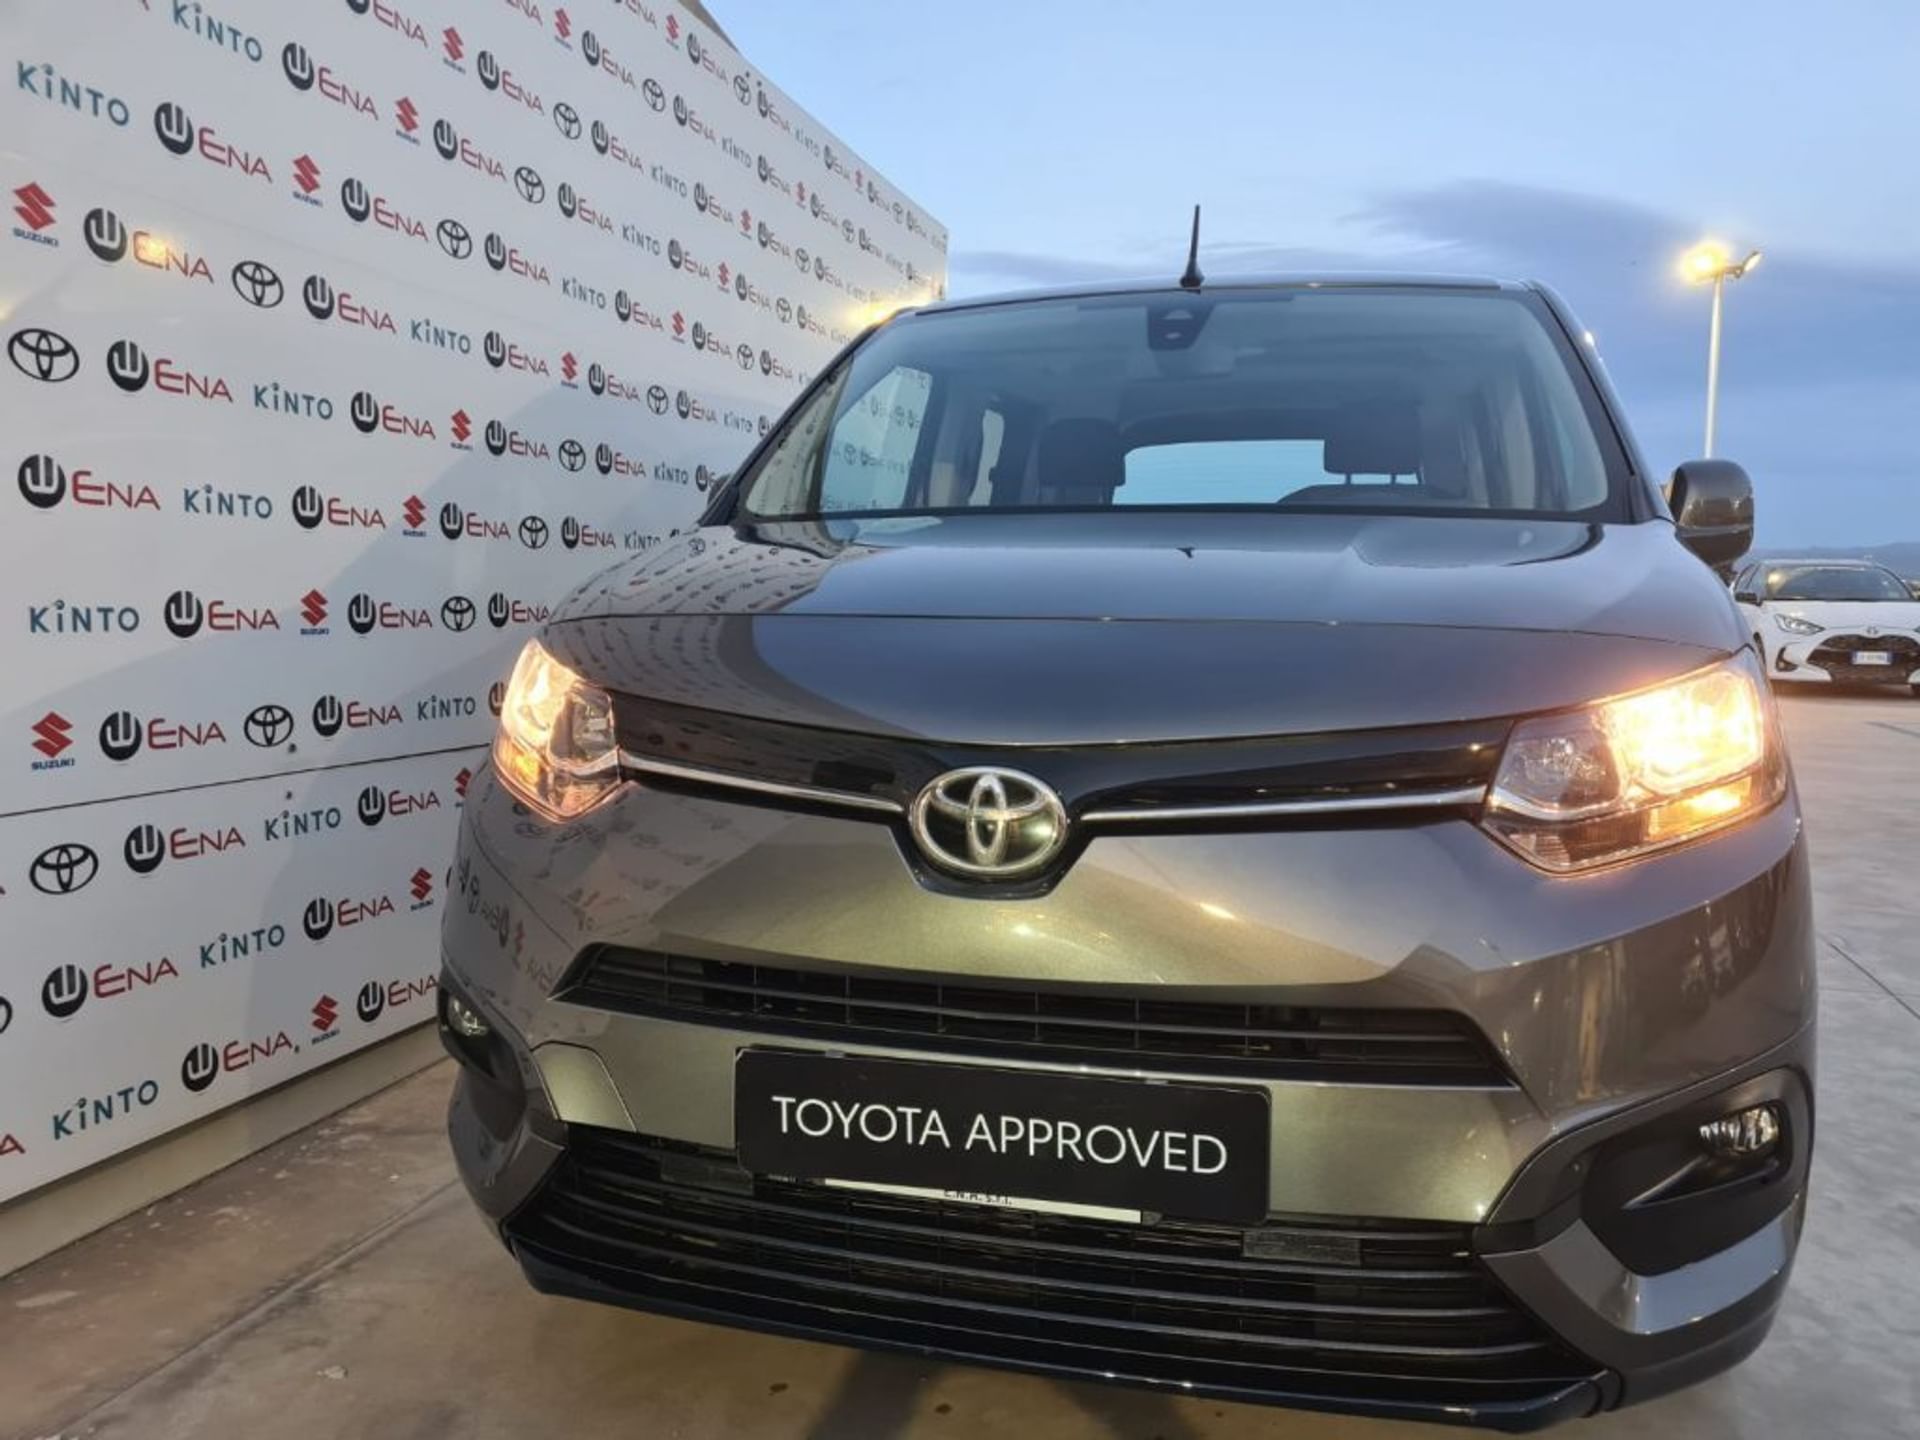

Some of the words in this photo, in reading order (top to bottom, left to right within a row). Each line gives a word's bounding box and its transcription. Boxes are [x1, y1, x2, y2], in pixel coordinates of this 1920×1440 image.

[601, 48, 636, 89] ENA
[318, 66, 378, 120] ENA
[502, 70, 545, 116] ENA
[199, 127, 272, 183] ENA
[460, 138, 507, 182] ENA
[610, 136, 644, 173] ENA
[374, 197, 428, 243] ENA
[578, 198, 614, 233] ENA
[12, 228, 59, 247] SUZUKI
[133, 231, 214, 284] ENA
[509, 249, 550, 284] ENA
[338, 294, 396, 335] ENA
[633, 303, 663, 332] ENA
[508, 345, 549, 376] ENA
[155, 359, 233, 402] ENA
[607, 375, 640, 402] ENA
[382, 405, 436, 440] ENA
[509, 431, 550, 460] ENA
[614, 452, 646, 478] ENA
[72, 470, 160, 510] ENA
[328, 497, 386, 529] ENA
[466, 512, 511, 539] ENA
[581, 525, 616, 549] ENA
[208, 600, 280, 631] ENA
[380, 602, 432, 629] ENA
[511, 600, 549, 623] ENA
[347, 701, 403, 728] ENA
[147, 717, 226, 750] ENA
[31, 757, 75, 771] SUZUKI
[388, 790, 441, 816] ENA
[170, 827, 246, 860] ENA
[338, 895, 395, 927] ENA
[94, 958, 179, 999] ENA
[387, 975, 440, 1007] ENA
[223, 1031, 293, 1072] ENA
[772, 1095, 951, 1149] TOYOTA
[964, 1113, 1228, 1175] APPROVED
